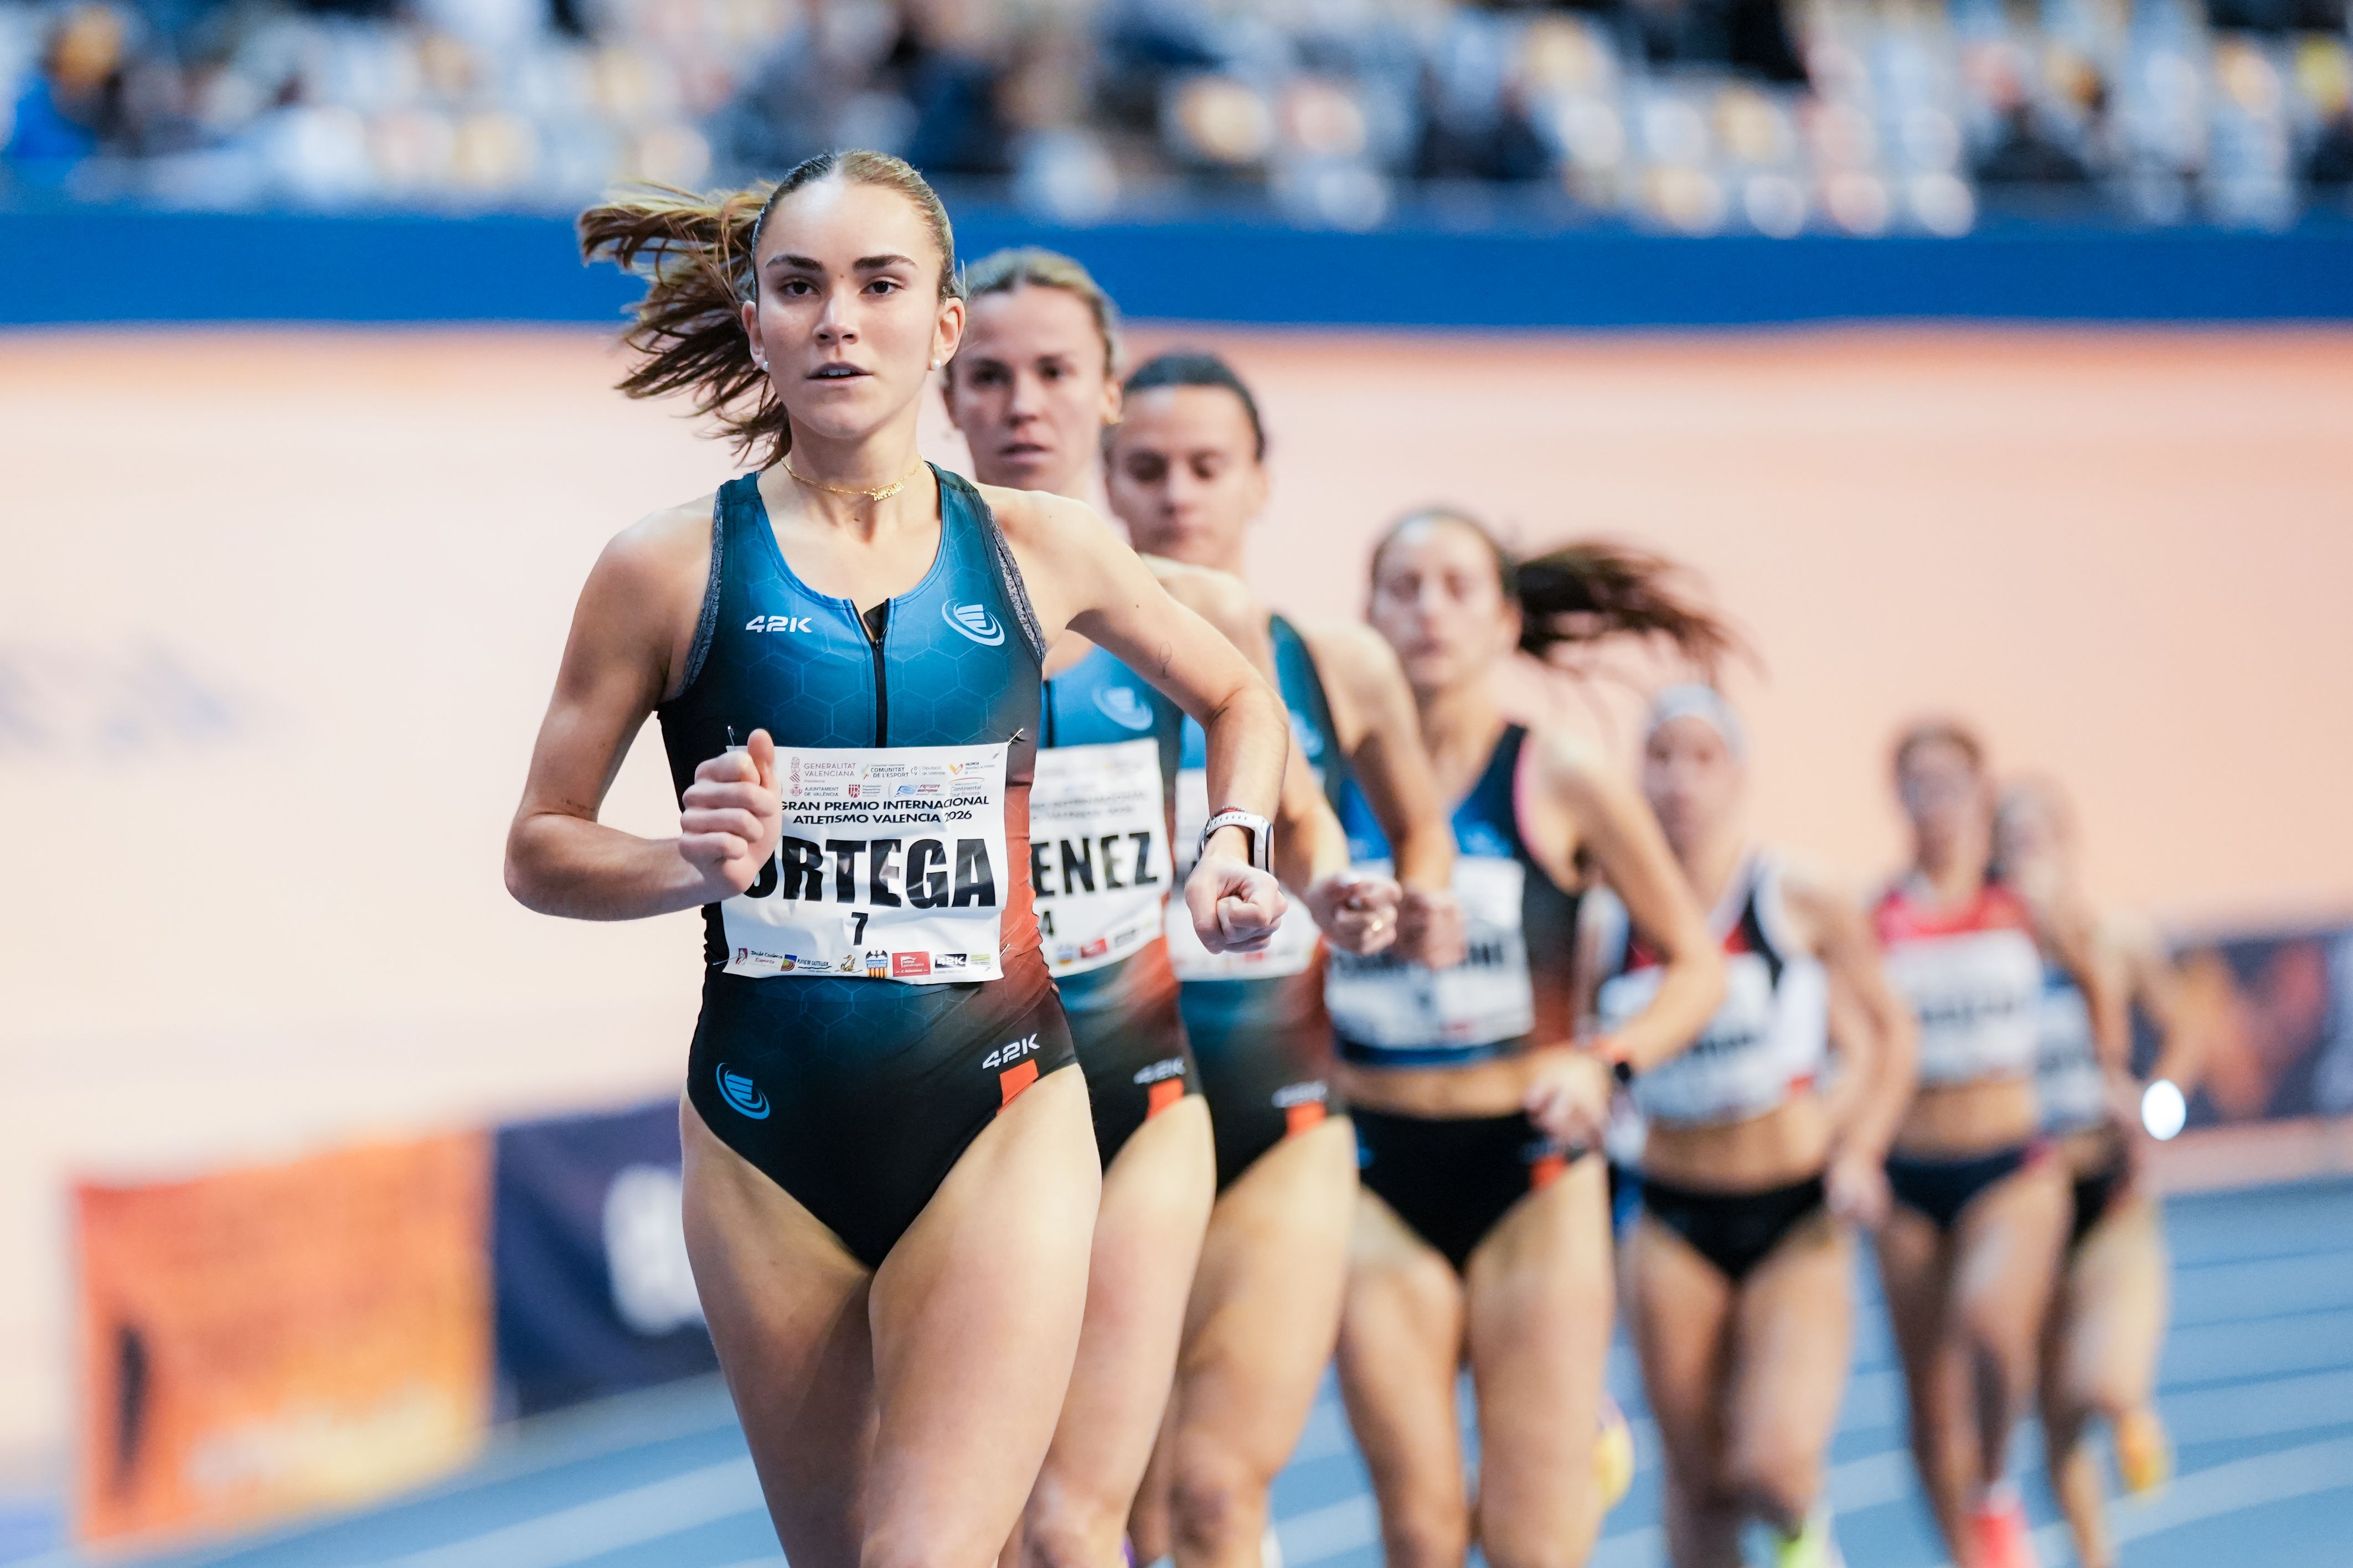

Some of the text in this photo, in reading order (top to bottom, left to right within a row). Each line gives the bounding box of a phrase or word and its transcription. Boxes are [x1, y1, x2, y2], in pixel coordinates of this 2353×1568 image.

[745, 615, 813, 634] 42K
[825, 801, 879, 810] PREMIO
[883, 796, 989, 810] INTERNACIONAL
[793, 810, 972, 824] ATLETISMO VALENCIA 2026
[851, 912, 868, 946] 7
[937, 956, 964, 966] 42K
[982, 1033, 1040, 1070] 42K
